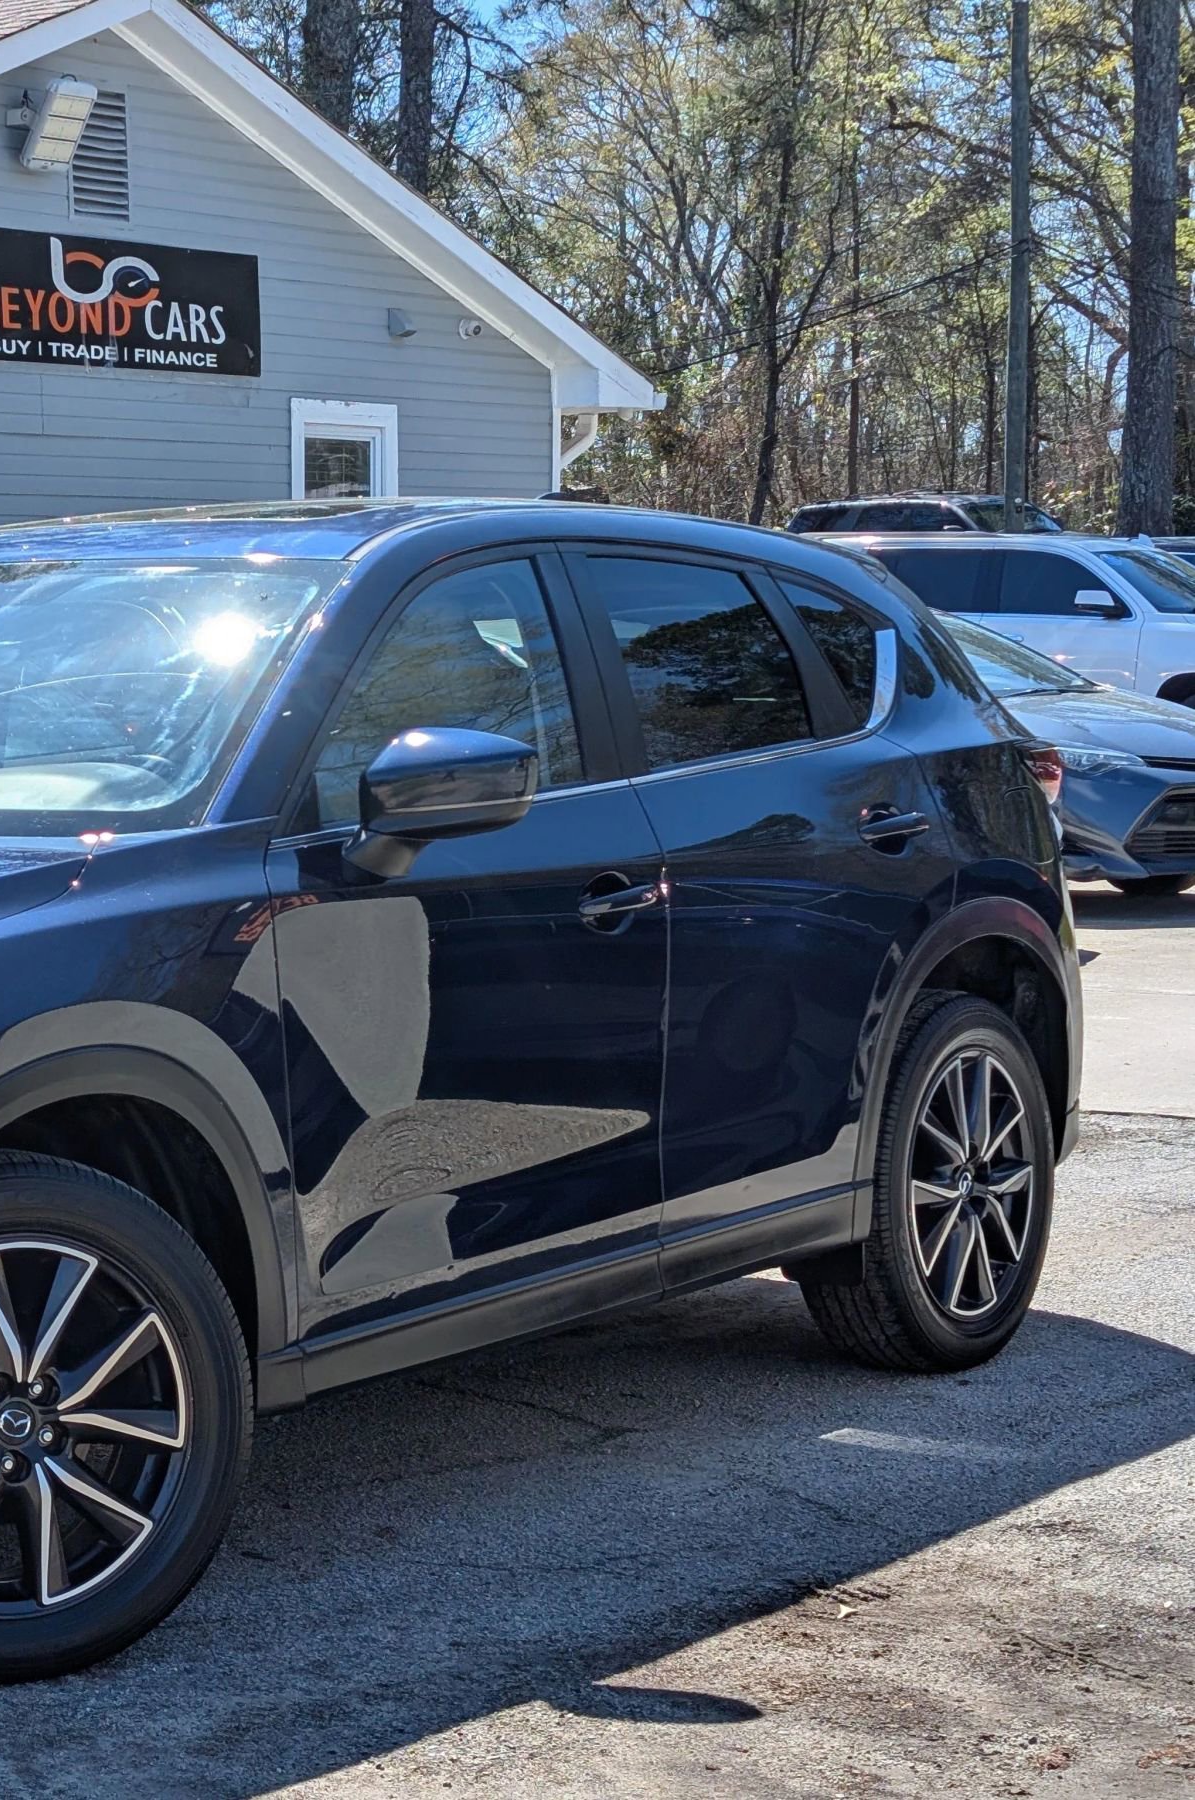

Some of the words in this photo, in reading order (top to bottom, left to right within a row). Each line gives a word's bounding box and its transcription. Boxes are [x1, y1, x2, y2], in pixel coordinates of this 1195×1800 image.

[144, 300, 227, 345] CARS
[48, 342, 118, 361] TRADE
[134, 348, 218, 368] FINANCE
